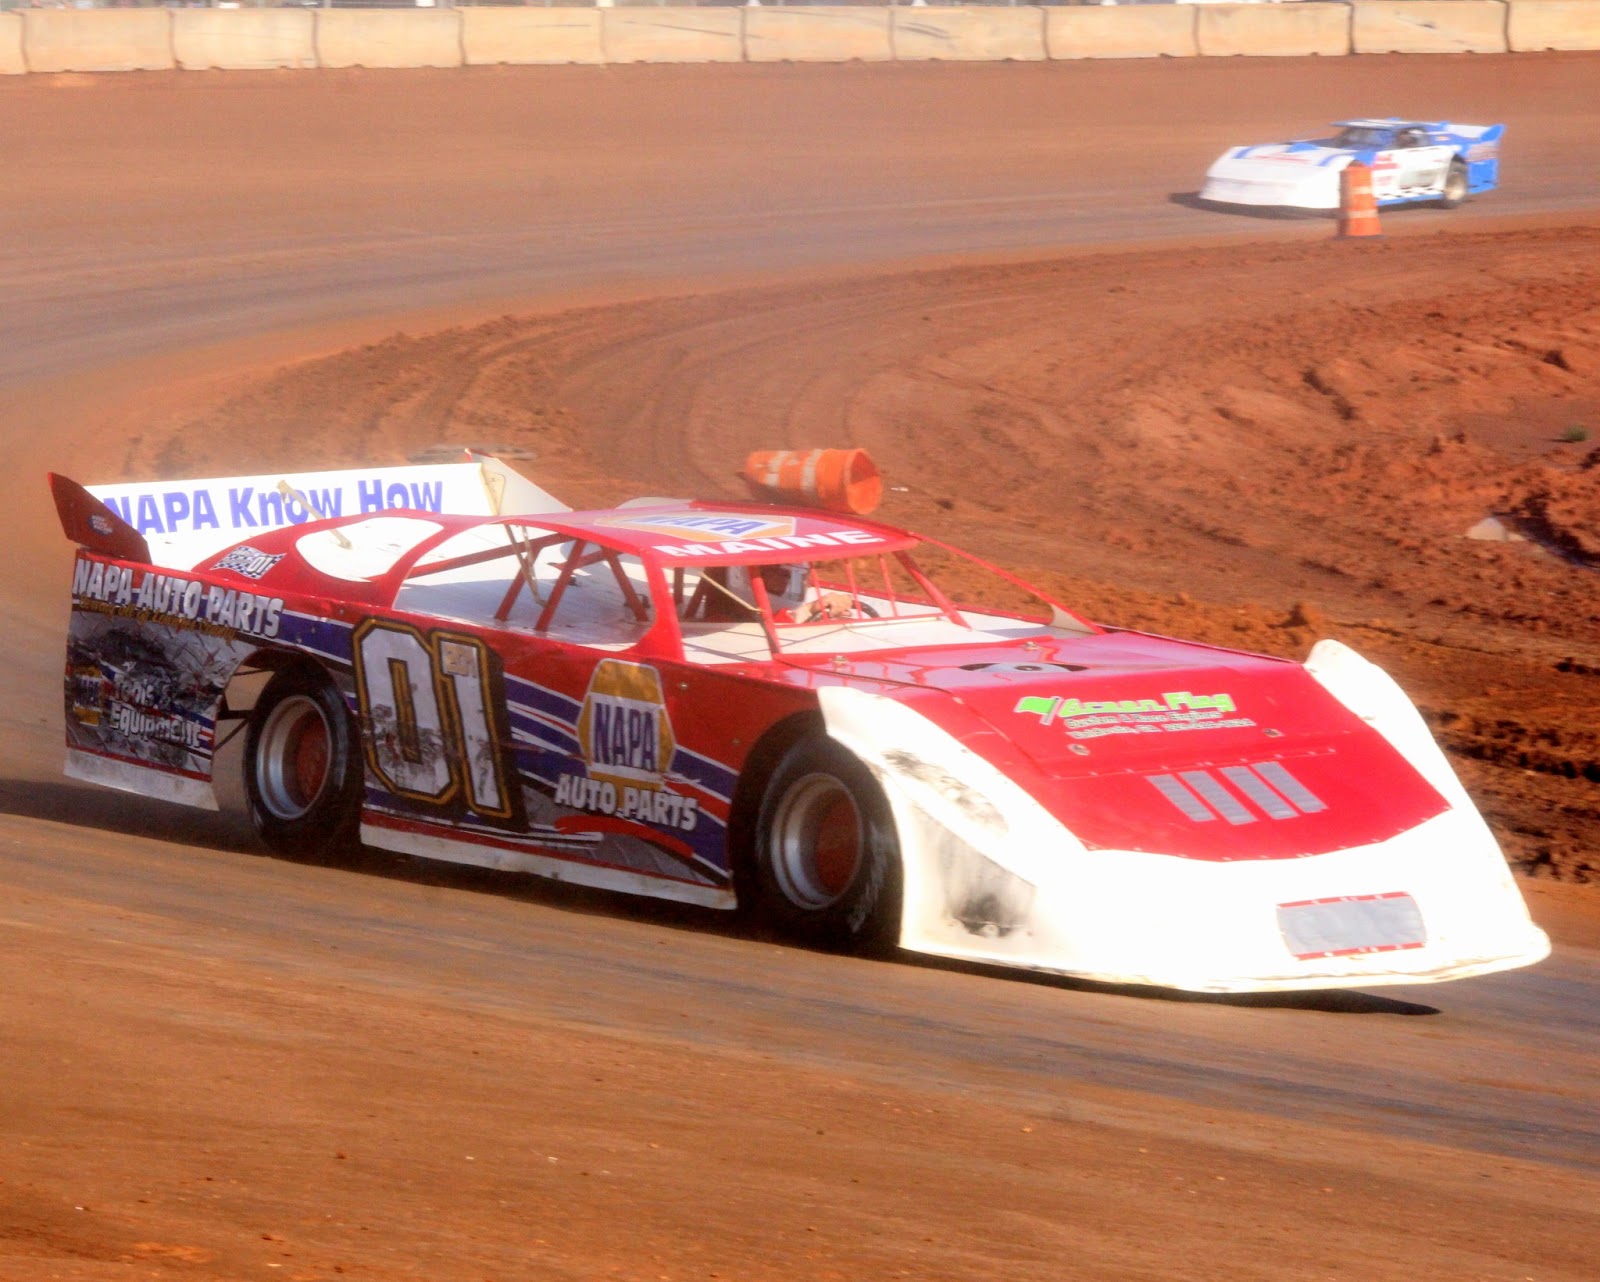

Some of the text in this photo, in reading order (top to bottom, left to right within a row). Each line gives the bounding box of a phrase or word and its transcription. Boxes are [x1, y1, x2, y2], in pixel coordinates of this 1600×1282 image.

[103, 489, 220, 535] NAPA
[228, 487, 342, 528] Know
[358, 479, 442, 514] How
[653, 530, 886, 557] MAINE
[72, 558, 284, 639] NAPA AUTO PARTS
[353, 617, 512, 819] 01
[594, 702, 657, 773] NAPA
[554, 772, 698, 832] AUTO PARTS
